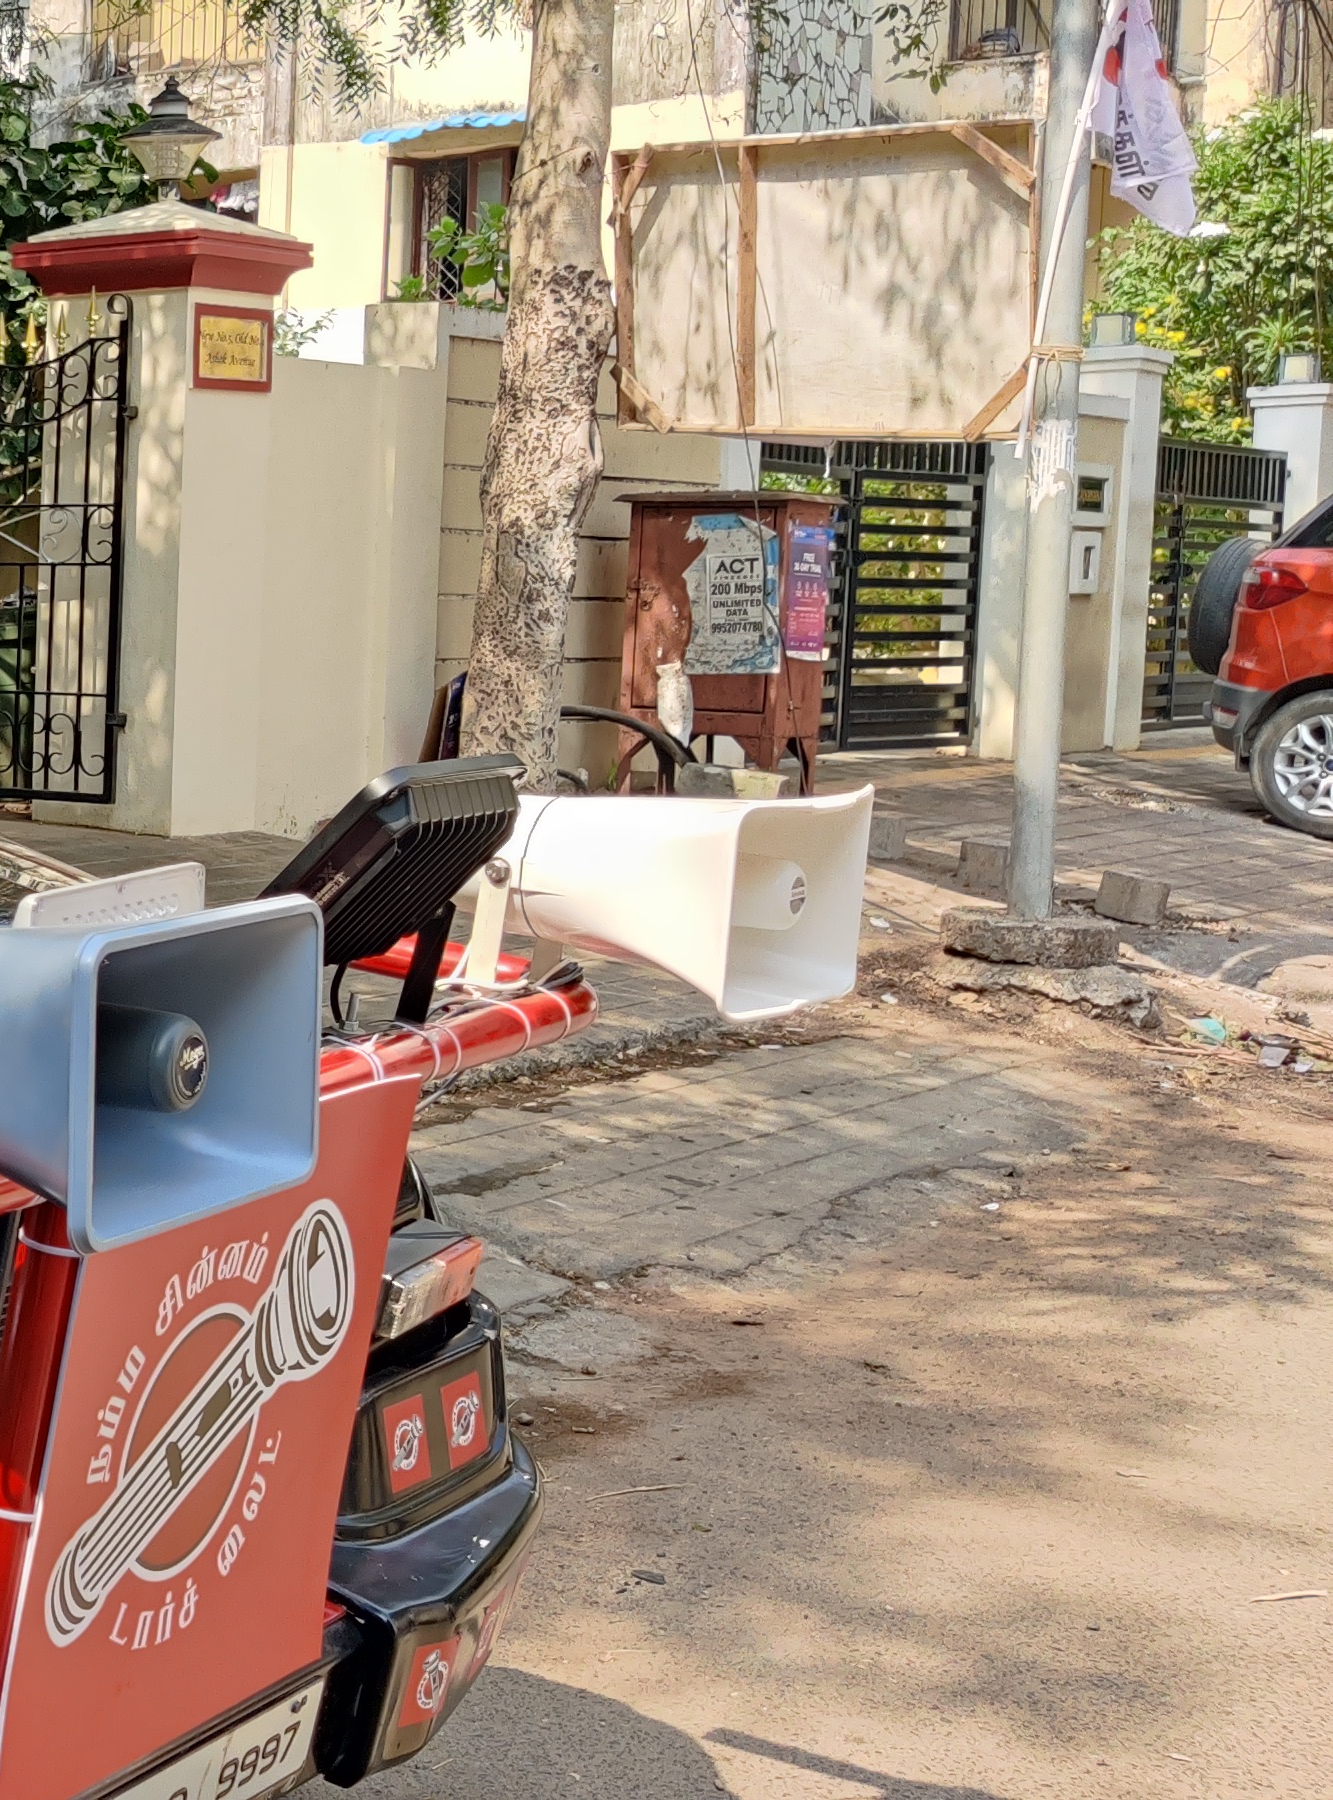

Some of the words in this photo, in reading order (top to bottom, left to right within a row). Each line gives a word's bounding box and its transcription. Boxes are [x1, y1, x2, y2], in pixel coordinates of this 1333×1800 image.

[711, 583, 731, 595] 200
[734, 583, 762, 596] Mbps
[715, 558, 759, 575] ACT
[712, 599, 761, 609] UNLIMITED
[726, 608, 748, 617] DATA
[155, 1231, 269, 1336] சின்னம்
[86, 1345, 146, 1485] நம்ம
[109, 1577, 199, 1650] டார்ச்
[217, 1430, 282, 1577] லைட்
[217, 1721, 301, 1800] 9997
